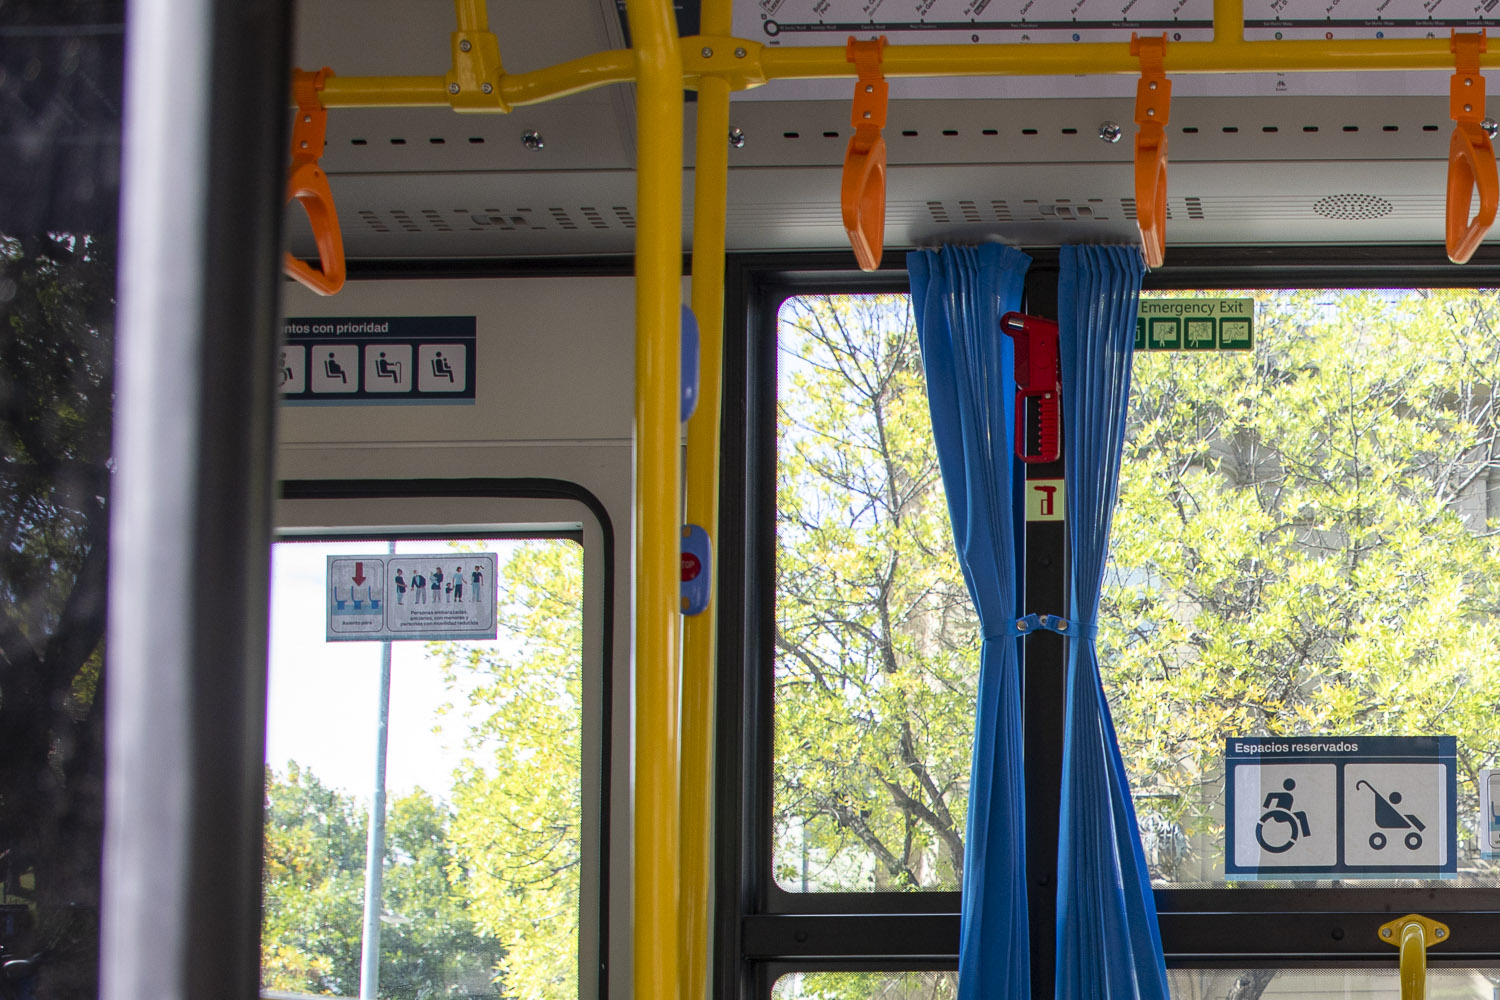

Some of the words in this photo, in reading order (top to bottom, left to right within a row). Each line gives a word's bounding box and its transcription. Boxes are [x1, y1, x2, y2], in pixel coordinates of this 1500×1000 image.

[1142, 302, 1216, 316] Emergency
[1220, 301, 1243, 313] Exit
[312, 323, 334, 333] con
[336, 322, 389, 336] prioridad
[680, 559, 695, 569] TOP
[1234, 741, 1290, 754] Espacios
[1292, 741, 1359, 753] reservados
